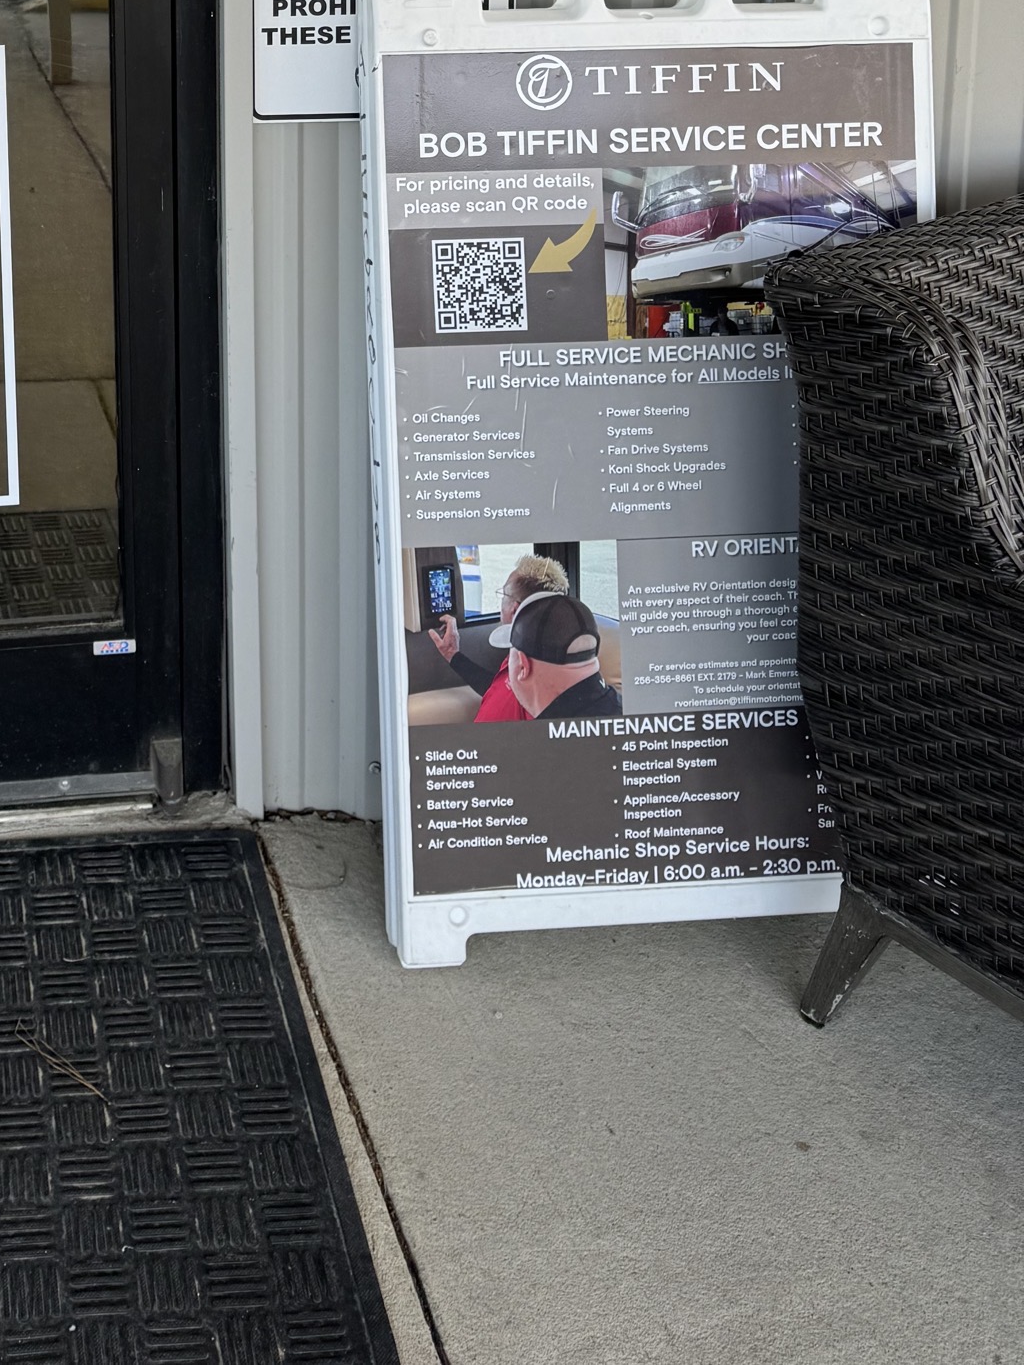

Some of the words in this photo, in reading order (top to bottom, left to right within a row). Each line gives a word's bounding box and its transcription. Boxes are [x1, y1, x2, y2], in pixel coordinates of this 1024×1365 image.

[262, 26, 351, 46] THESE
[585, 62, 784, 95] TIFFIN
[419, 132, 487, 158] BOB
[497, 129, 597, 156] TIFFIN
[610, 126, 746, 153] SERVICE
[757, 122, 882, 149] CENTER
[396, 177, 424, 192] For
[430, 176, 489, 194] pricing
[496, 174, 527, 189] and
[533, 173, 594, 188] details,
[404, 199, 460, 218] please
[466, 201, 506, 212] scan
[512, 196, 538, 213] QR
[544, 195, 587, 210] code
[500, 350, 550, 368] FULL
[556, 347, 641, 365] SERVICE
[648, 343, 755, 362] MECHANIC
[763, 342, 787, 358] SH
[467, 375, 495, 389] Full
[500, 374, 559, 388] Service
[565, 372, 666, 386] Maintenance
[671, 368, 693, 383] for
[698, 368, 718, 382] All
[724, 366, 780, 380] Models
[607, 407, 640, 417] Power
[644, 405, 689, 417] Steering
[412, 413, 428, 423] Oil
[431, 413, 480, 424] Changes
[413, 432, 469, 442] Generator
[473, 430, 523, 440] Services
[607, 426, 653, 438] Systems
[414, 450, 484, 461] Transmission
[488, 449, 535, 459] Services
[608, 445, 628, 455] Fan
[631, 444, 660, 454] Drive
[663, 443, 708, 455] Systems
[609, 464, 632, 474] Koni
[636, 462, 670, 473] Shock
[674, 461, 726, 473] Upgrades
[414, 471, 439, 481] Axle
[442, 470, 490, 480] Services
[692, 540, 718, 557] RV
[724, 537, 798, 555] ORIENT
[549, 715, 695, 738] MAINTENANCE
[702, 710, 798, 730] SERVICES
[622, 741, 636, 751] 45
[640, 740, 668, 750] Point
[671, 737, 728, 750] Inspection
[426, 751, 453, 761] Slide
[456, 749, 478, 760] Out
[426, 765, 497, 776] Maintenance
[623, 758, 673, 771] Electrical
[677, 758, 717, 770] System
[427, 779, 474, 790] Services
[623, 774, 680, 787] Inspection
[427, 800, 468, 811] Battery
[471, 796, 513, 808] Service
[428, 817, 482, 831] Aqua-Hot
[486, 815, 528, 826] Service
[547, 844, 629, 862] Mechanic
[635, 842, 680, 860] Shop
[686, 838, 750, 855] Service
[756, 836, 809, 851] Hours:
[664, 864, 706, 881] 6:00
[710, 866, 745, 878] a.m.
[763, 858, 801, 875] 2:30
[806, 859, 840, 874] p.m.
